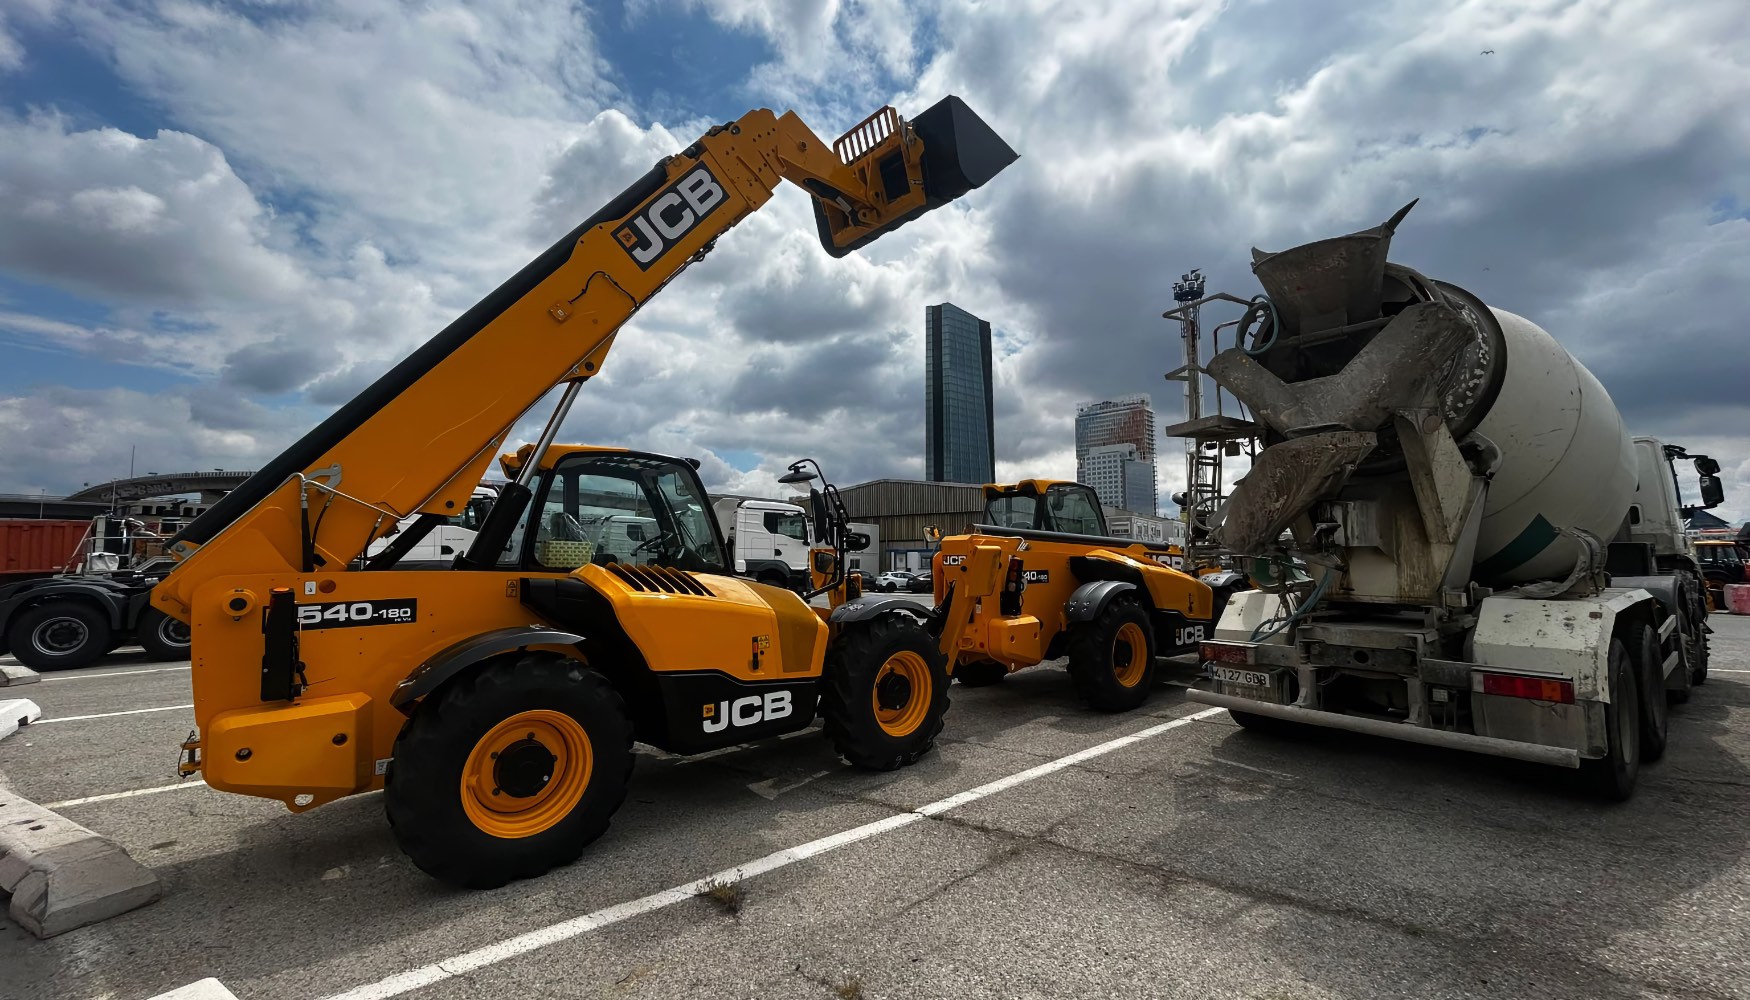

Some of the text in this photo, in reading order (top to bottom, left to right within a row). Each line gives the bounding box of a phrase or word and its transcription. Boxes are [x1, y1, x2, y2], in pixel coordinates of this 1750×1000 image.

[632, 169, 723, 263] JCB
[1022, 571, 1047, 580] 40-180
[1176, 625, 1204, 645] JCB
[1215, 668, 1266, 685] 4127 GDB
[703, 690, 793, 733] JCB
